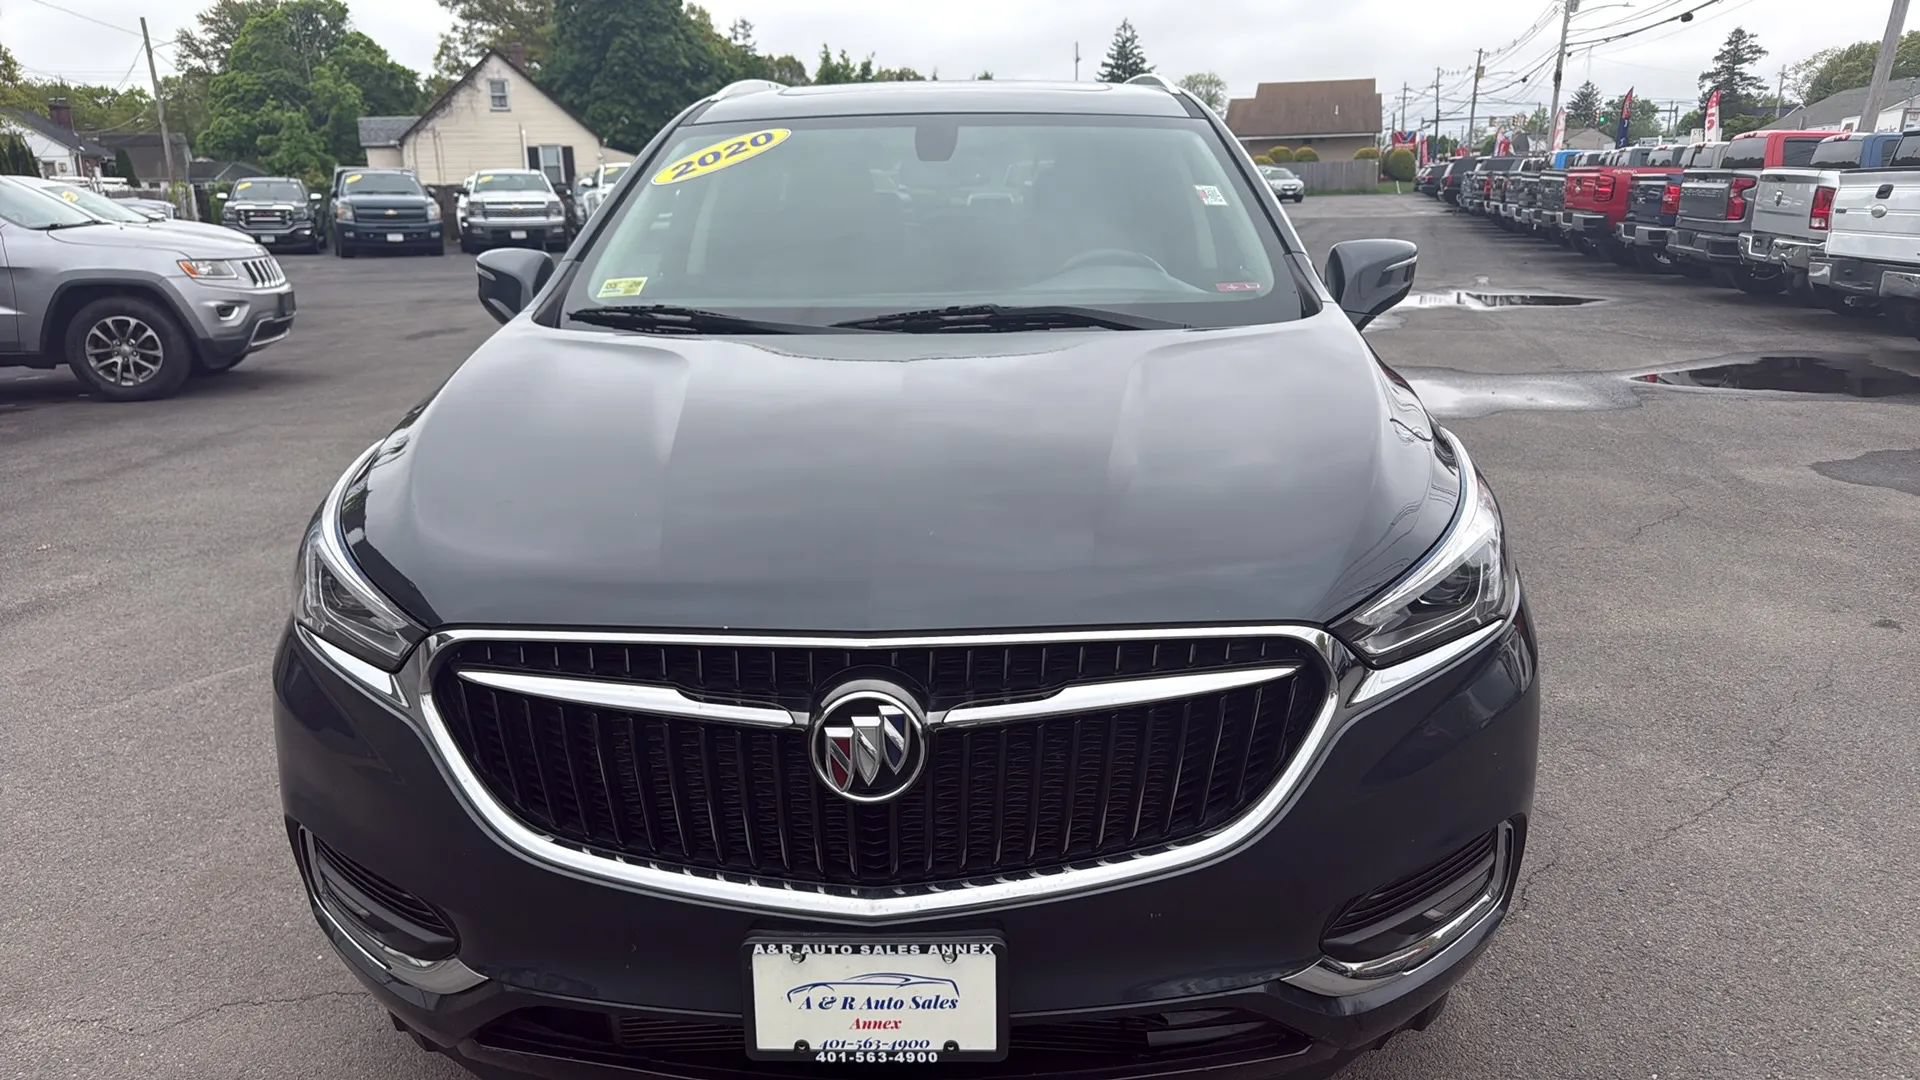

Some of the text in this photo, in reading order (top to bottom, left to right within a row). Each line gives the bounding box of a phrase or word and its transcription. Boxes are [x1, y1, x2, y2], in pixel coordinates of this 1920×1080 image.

[671, 132, 774, 181] 2020
[753, 944, 995, 955] A&R AUTO SALES ANNEX
[798, 995, 958, 1010] A & R Auto Sales
[849, 1017, 902, 1030] Annex
[819, 1036, 930, 1051] 401-563-4900
[815, 1051, 938, 1063] 401-563-4900
